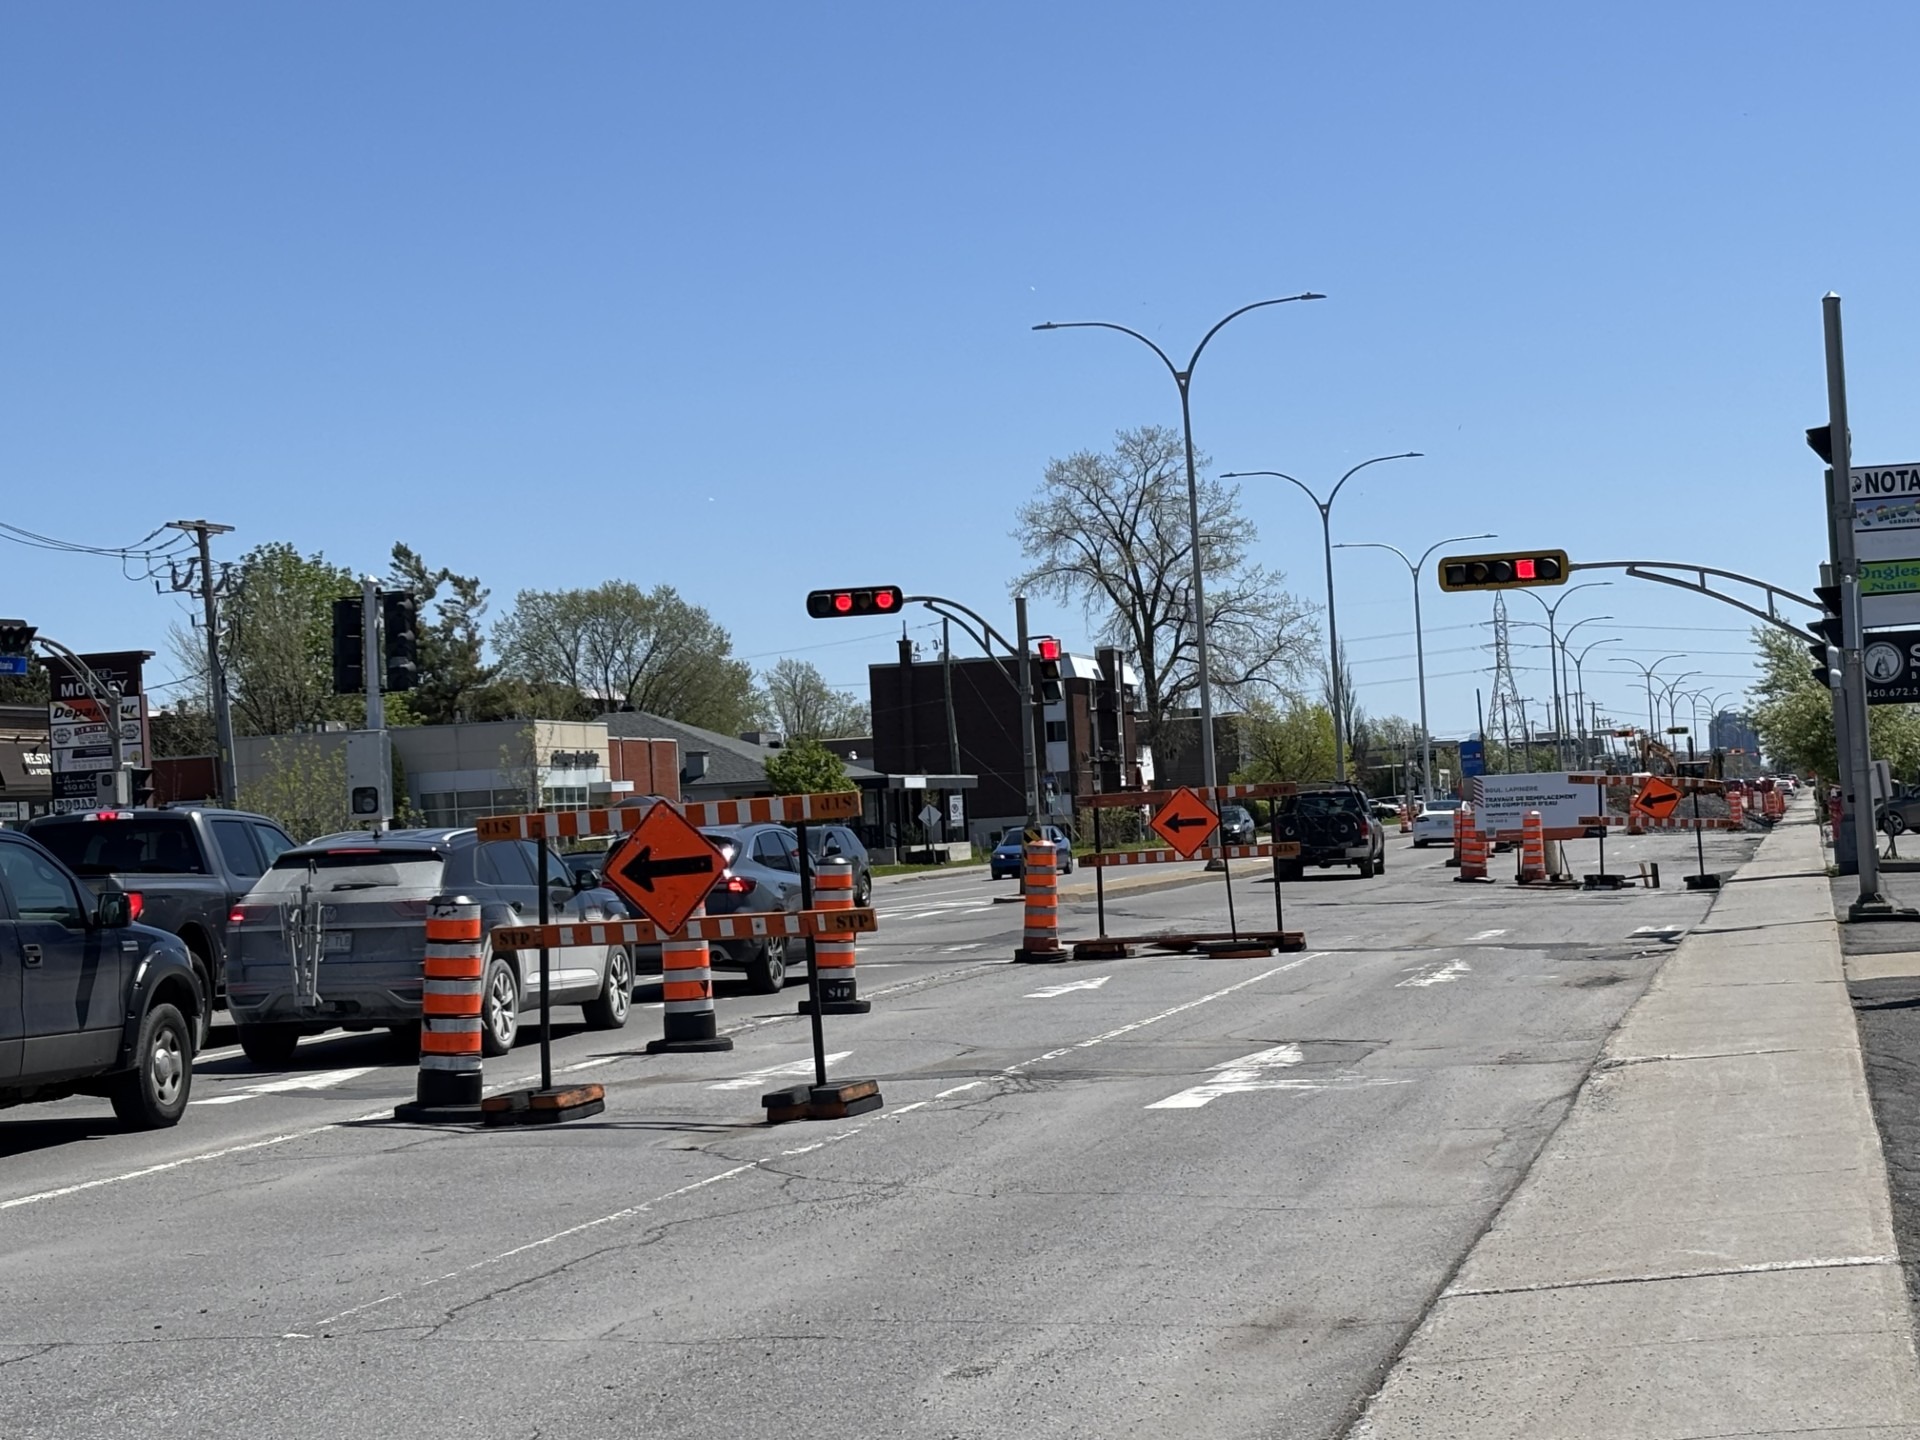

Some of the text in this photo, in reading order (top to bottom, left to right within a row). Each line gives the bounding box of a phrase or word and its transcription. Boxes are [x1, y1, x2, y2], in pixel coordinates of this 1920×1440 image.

[1865, 469, 1920, 494] NOTA
[1869, 581, 1917, 591] Nails
[836, 914, 869, 928] STP
[500, 932, 530, 945] STP
[828, 987, 850, 998] STP
